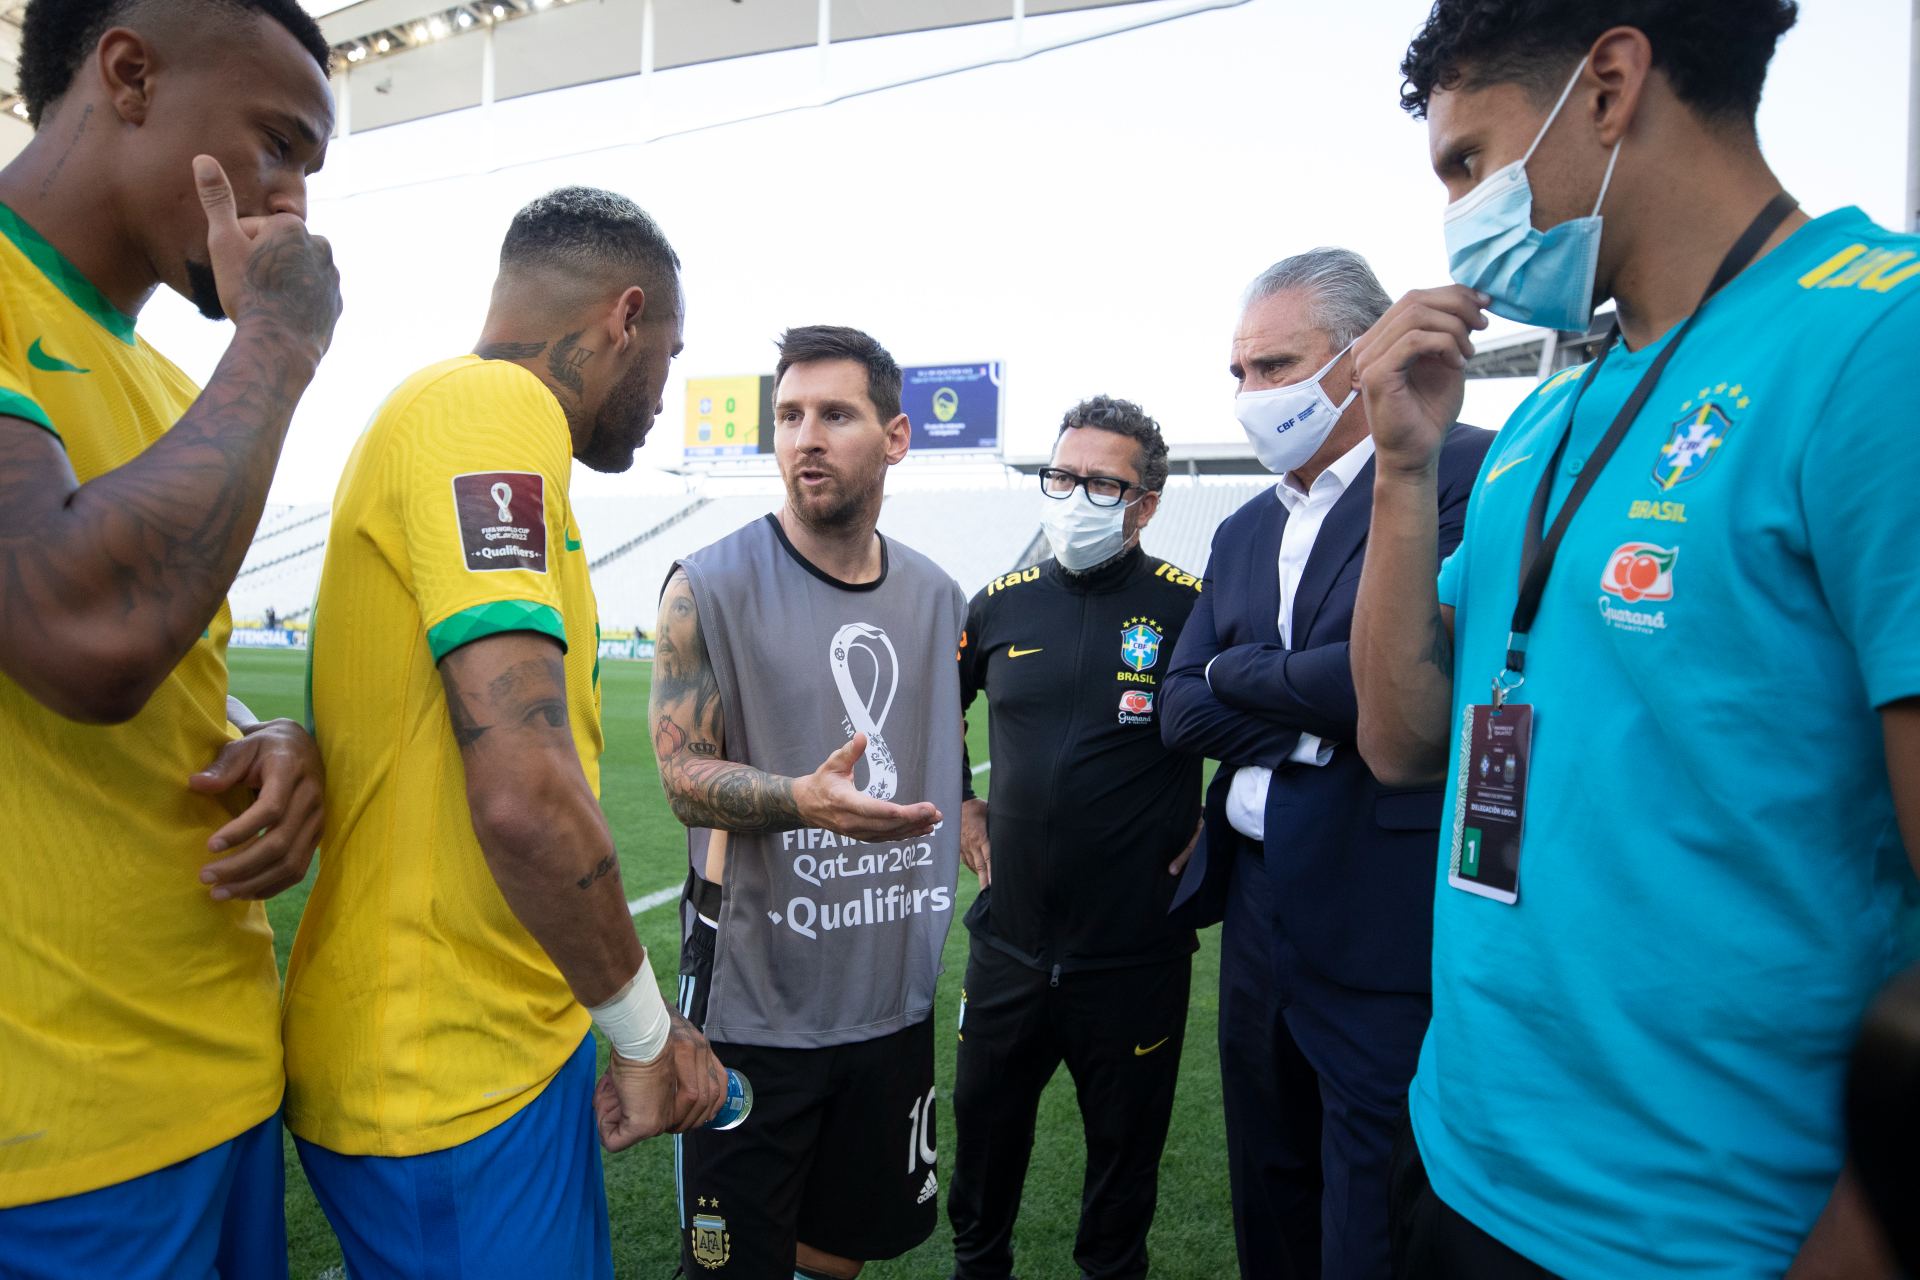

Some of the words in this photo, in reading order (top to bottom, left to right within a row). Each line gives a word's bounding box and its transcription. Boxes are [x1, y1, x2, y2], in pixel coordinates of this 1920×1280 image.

[725, 397, 735, 414] 0
[725, 421, 735, 439] 0
[1276, 418, 1296, 434] CBF
[1628, 500, 1688, 522] BRASIL
[482, 545, 535, 559] Qualifiers
[987, 566, 1040, 597] Itaú
[1598, 595, 1668, 629] Guaraná
[1133, 642, 1148, 650] CBF
[1117, 671, 1156, 685] BRASIL
[782, 827, 838, 851] FIFA
[1467, 839, 1476, 864] 1
[786, 884, 951, 940] Qualifiers
[908, 1085, 938, 1175] 10
[699, 1229, 721, 1255] AFA
